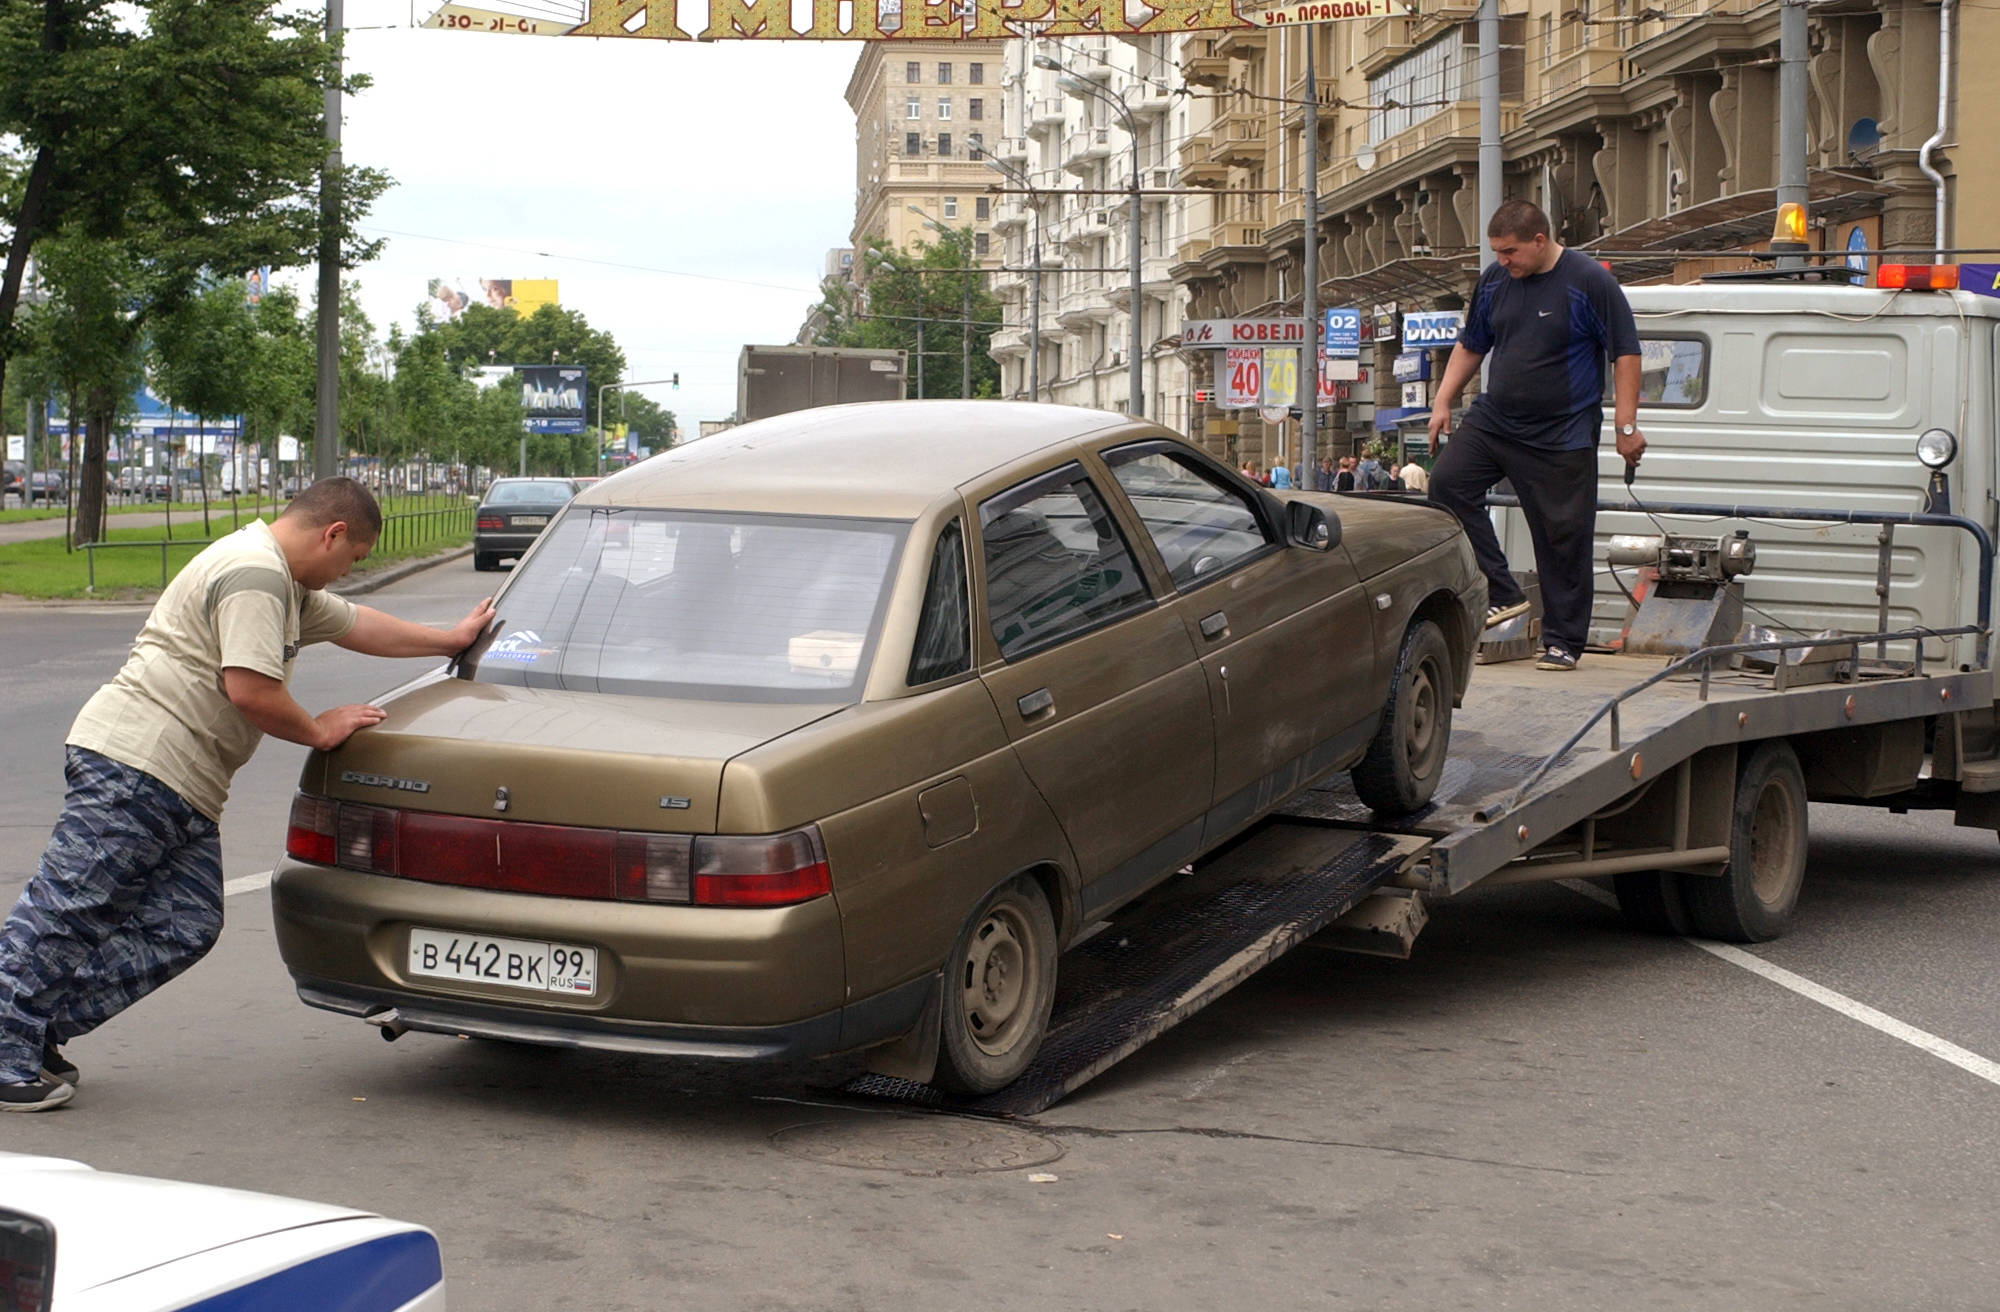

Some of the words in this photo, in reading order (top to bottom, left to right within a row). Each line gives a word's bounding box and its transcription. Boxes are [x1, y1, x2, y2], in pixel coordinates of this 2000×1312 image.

[1329, 315, 1357, 329] 02
[1406, 316, 1460, 342] DIXIS
[1227, 349, 1260, 361] СКИДКИ
[1231, 362, 1260, 396] 40
[1268, 361, 1297, 397] 40
[342, 772, 394, 788] LADA
[398, 779, 429, 792] 110
[553, 948, 584, 978] 99
[550, 976, 573, 989] RUS
